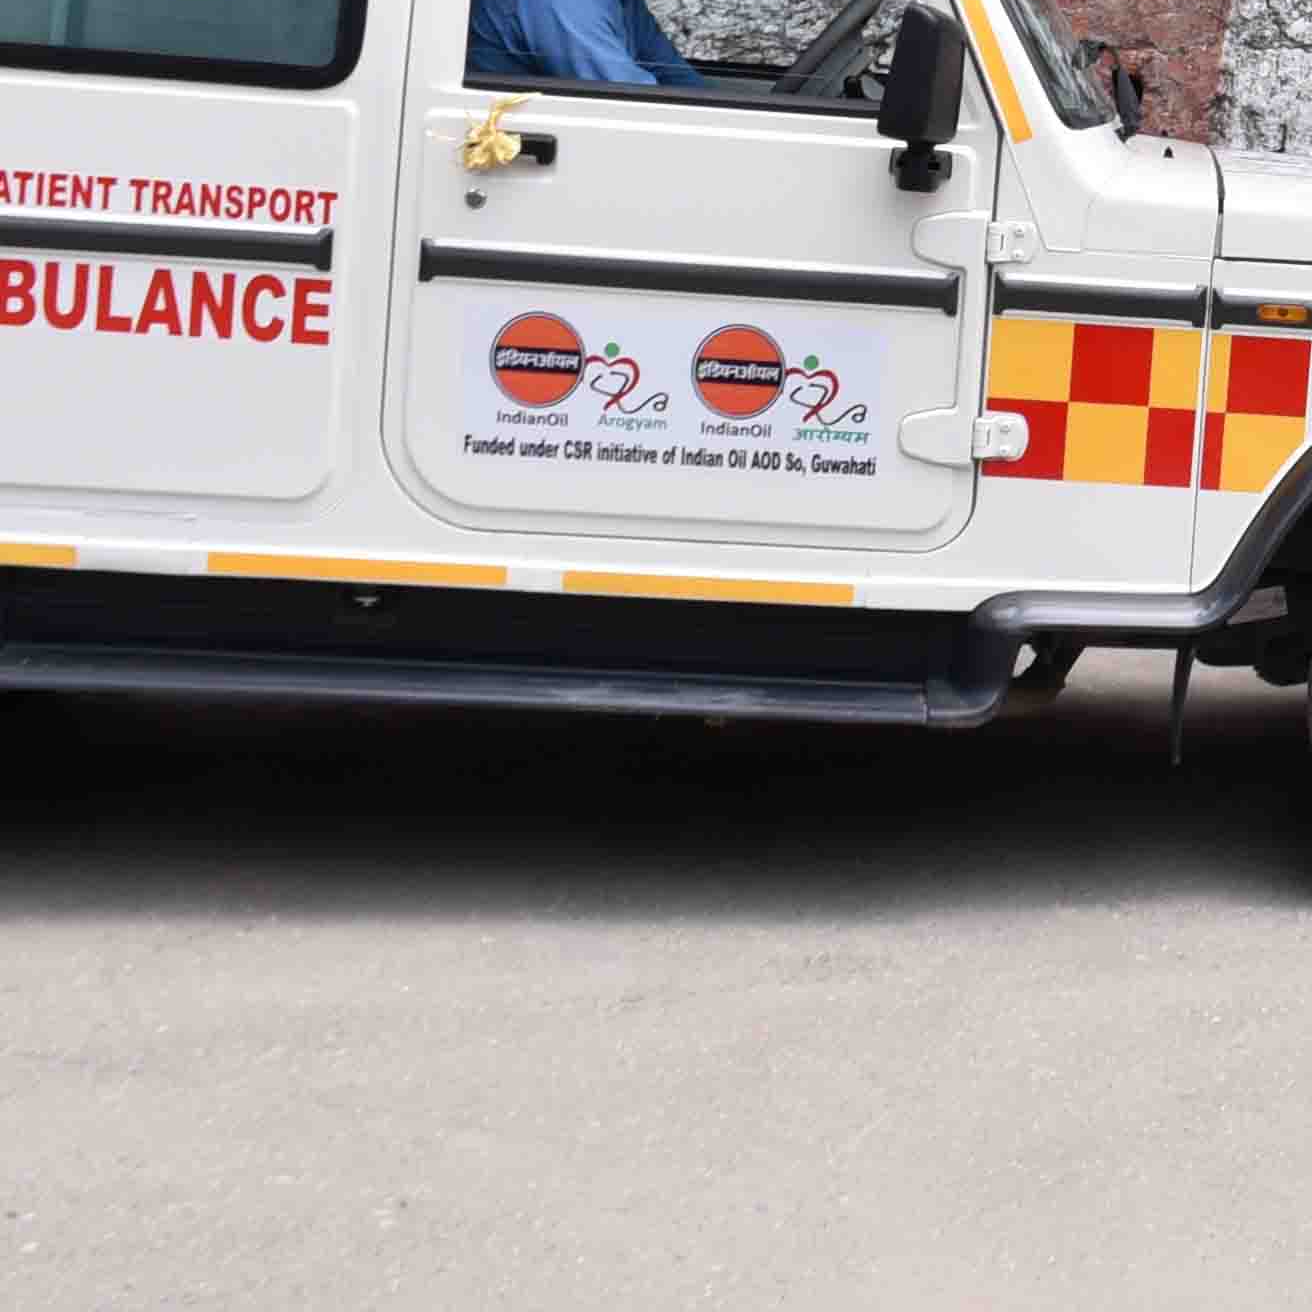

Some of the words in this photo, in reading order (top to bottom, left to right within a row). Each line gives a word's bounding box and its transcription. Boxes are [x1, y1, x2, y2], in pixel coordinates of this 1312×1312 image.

[130, 178, 338, 225] TRANSPORT
[0, 258, 333, 346] BULANCE
[496, 410, 568, 427] IndianOil
[597, 414, 668, 432] Arogyam
[700, 421, 772, 438] IndianOil
[463, 434, 514, 456] Funded
[519, 438, 559, 458] under
[564, 440, 592, 461] CSR
[597, 440, 657, 464] initiative
[662, 445, 677, 465] of
[681, 446, 723, 468] Indian
[728, 449, 746, 469] Oil
[751, 451, 781, 471] AOD
[811, 454, 876, 476] Guwahati
